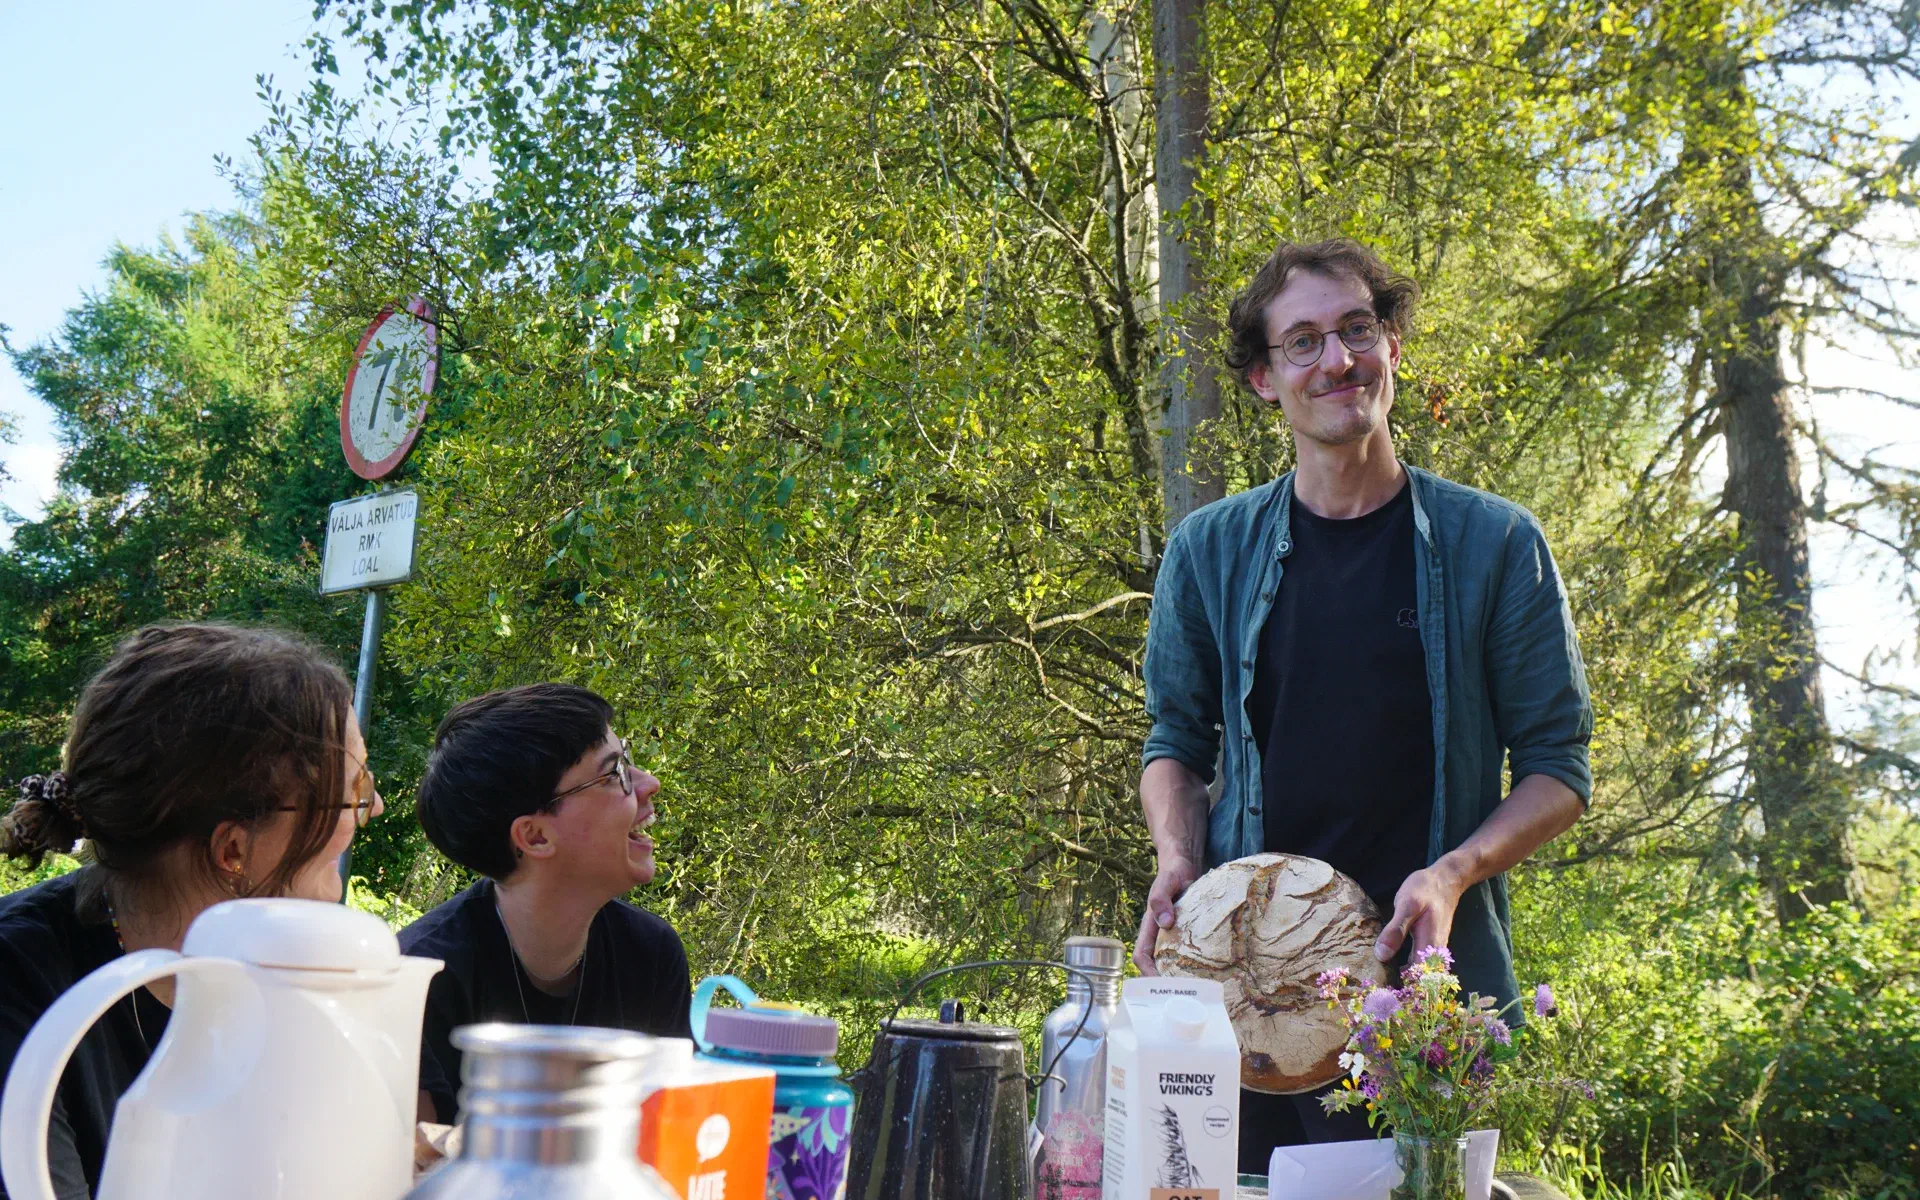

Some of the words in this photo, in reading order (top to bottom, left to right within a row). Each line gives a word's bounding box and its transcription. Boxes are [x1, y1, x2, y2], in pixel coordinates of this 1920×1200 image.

[331, 512, 363, 533] VÄLJA
[367, 500, 414, 526] ARVATUD
[359, 532, 381, 552] RMK
[352, 556, 379, 576] LOAL
[1150, 988, 1197, 996] PLANT-BASED
[1159, 1073, 1216, 1084] FRIENDLY
[1160, 1085, 1213, 1096] VIKING'S
